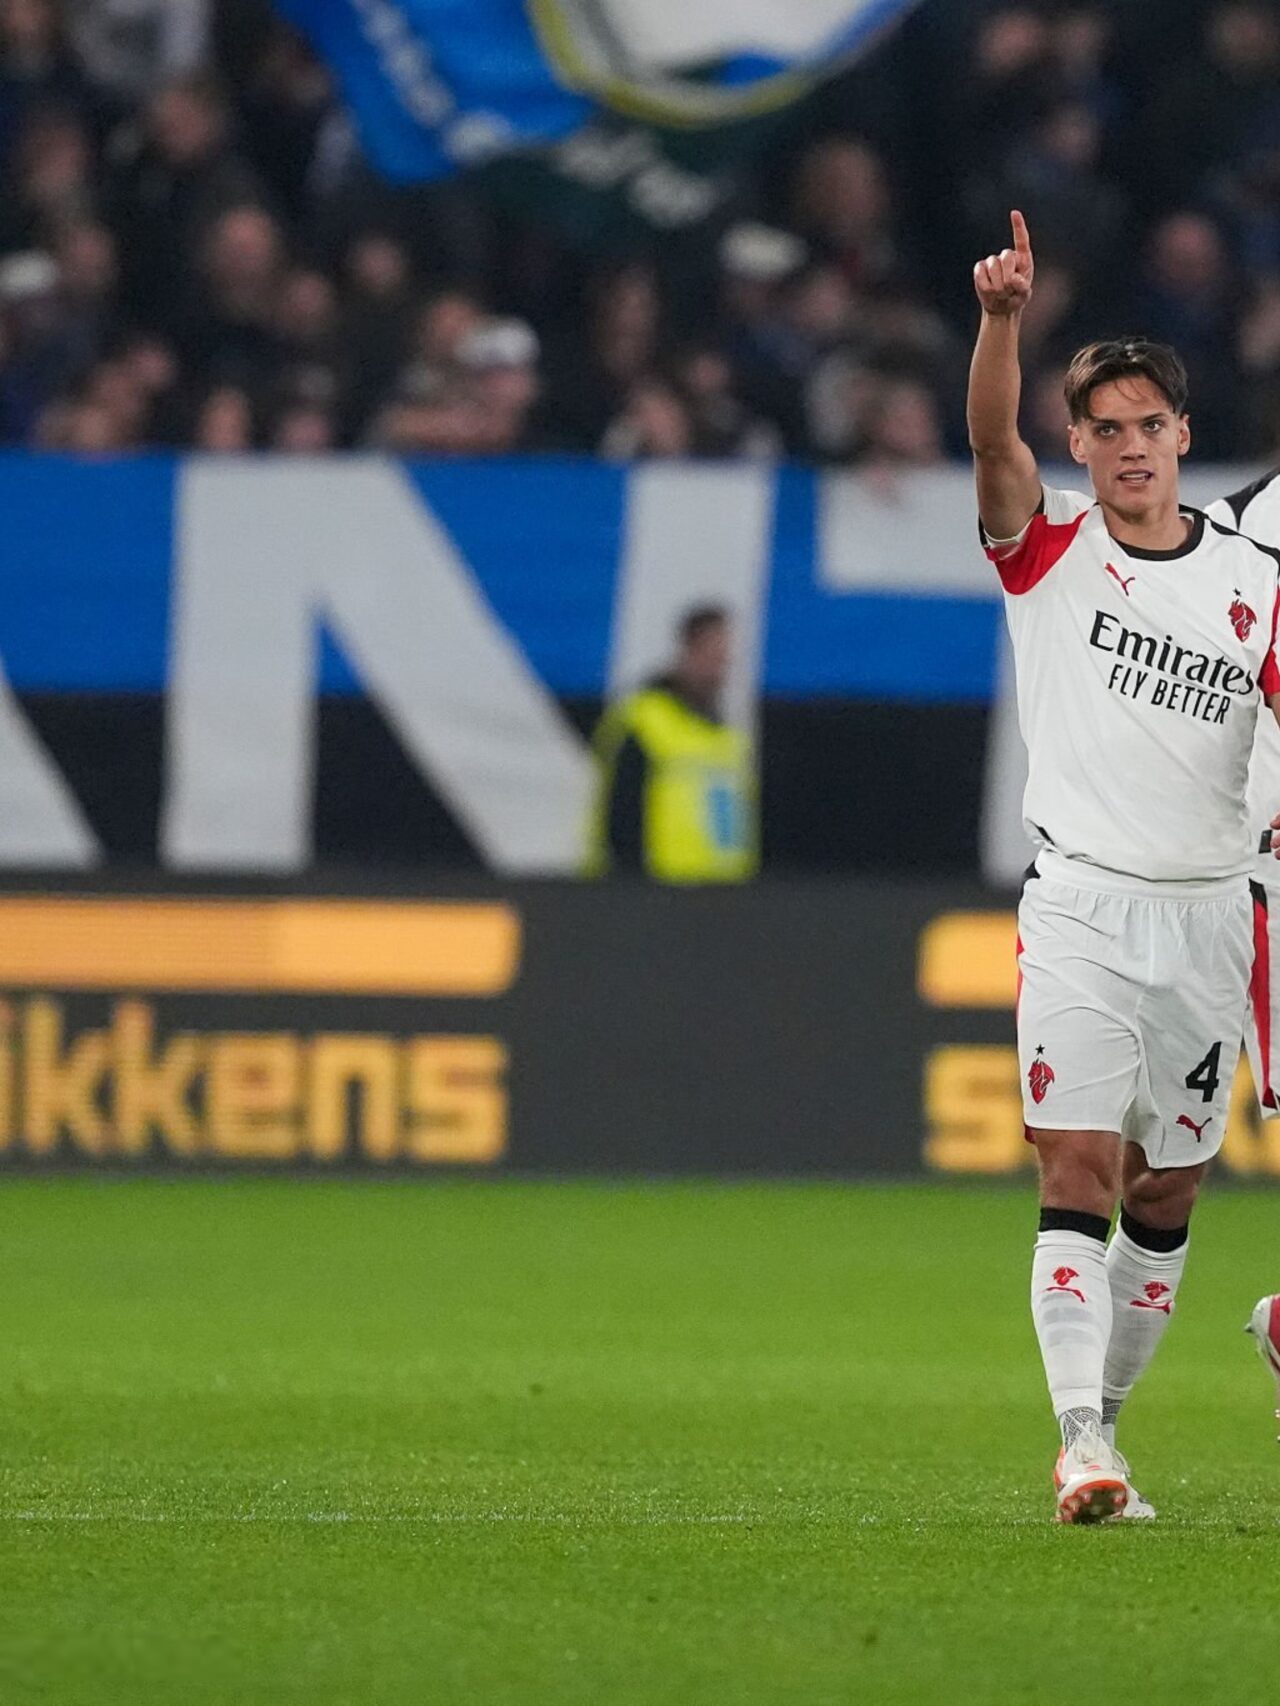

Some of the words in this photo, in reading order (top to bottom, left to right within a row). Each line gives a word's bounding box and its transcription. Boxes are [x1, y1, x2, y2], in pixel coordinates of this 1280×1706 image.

[1089, 609, 1256, 696] Emirates
[1107, 663, 1149, 700] FLY
[1150, 677, 1232, 725] BETTER
[1185, 1040, 1222, 1103] 4
